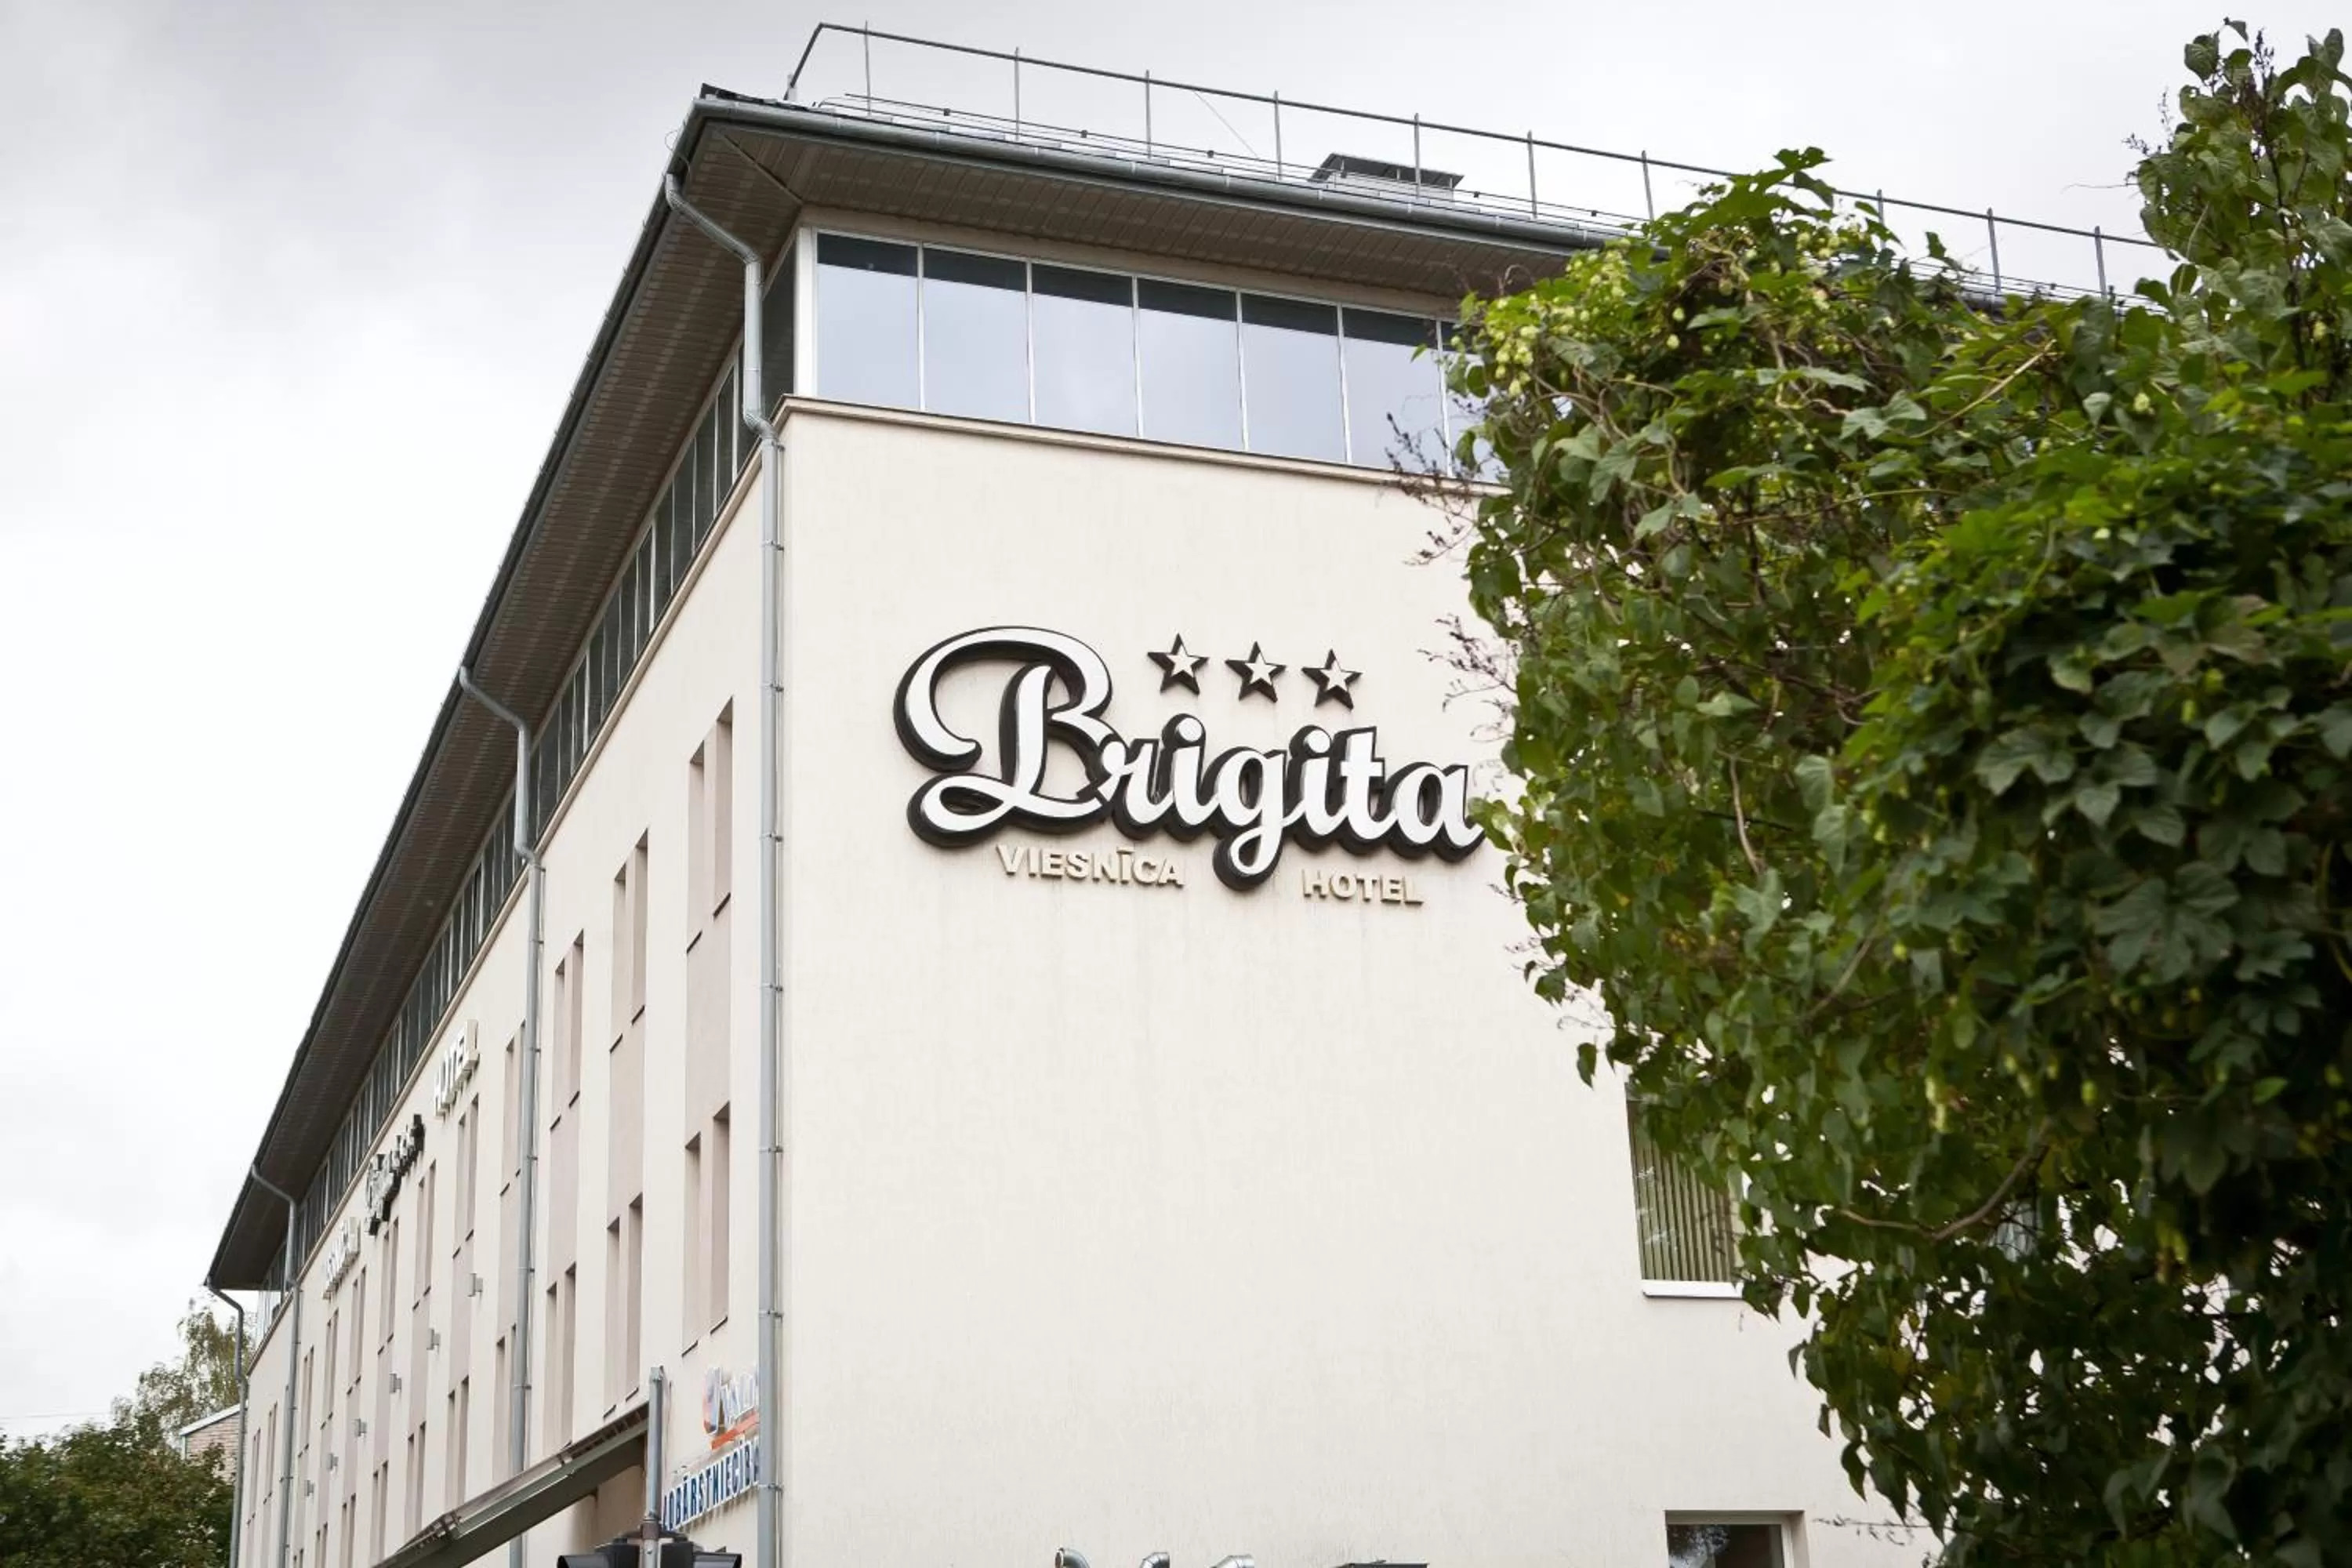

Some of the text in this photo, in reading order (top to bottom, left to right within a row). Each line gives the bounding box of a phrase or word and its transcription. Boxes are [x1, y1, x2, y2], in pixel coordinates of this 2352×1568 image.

[893, 626, 1486, 891] Brigita
[996, 844, 1184, 888] VIESNĪCA
[1301, 868, 1423, 906] HOTEL
